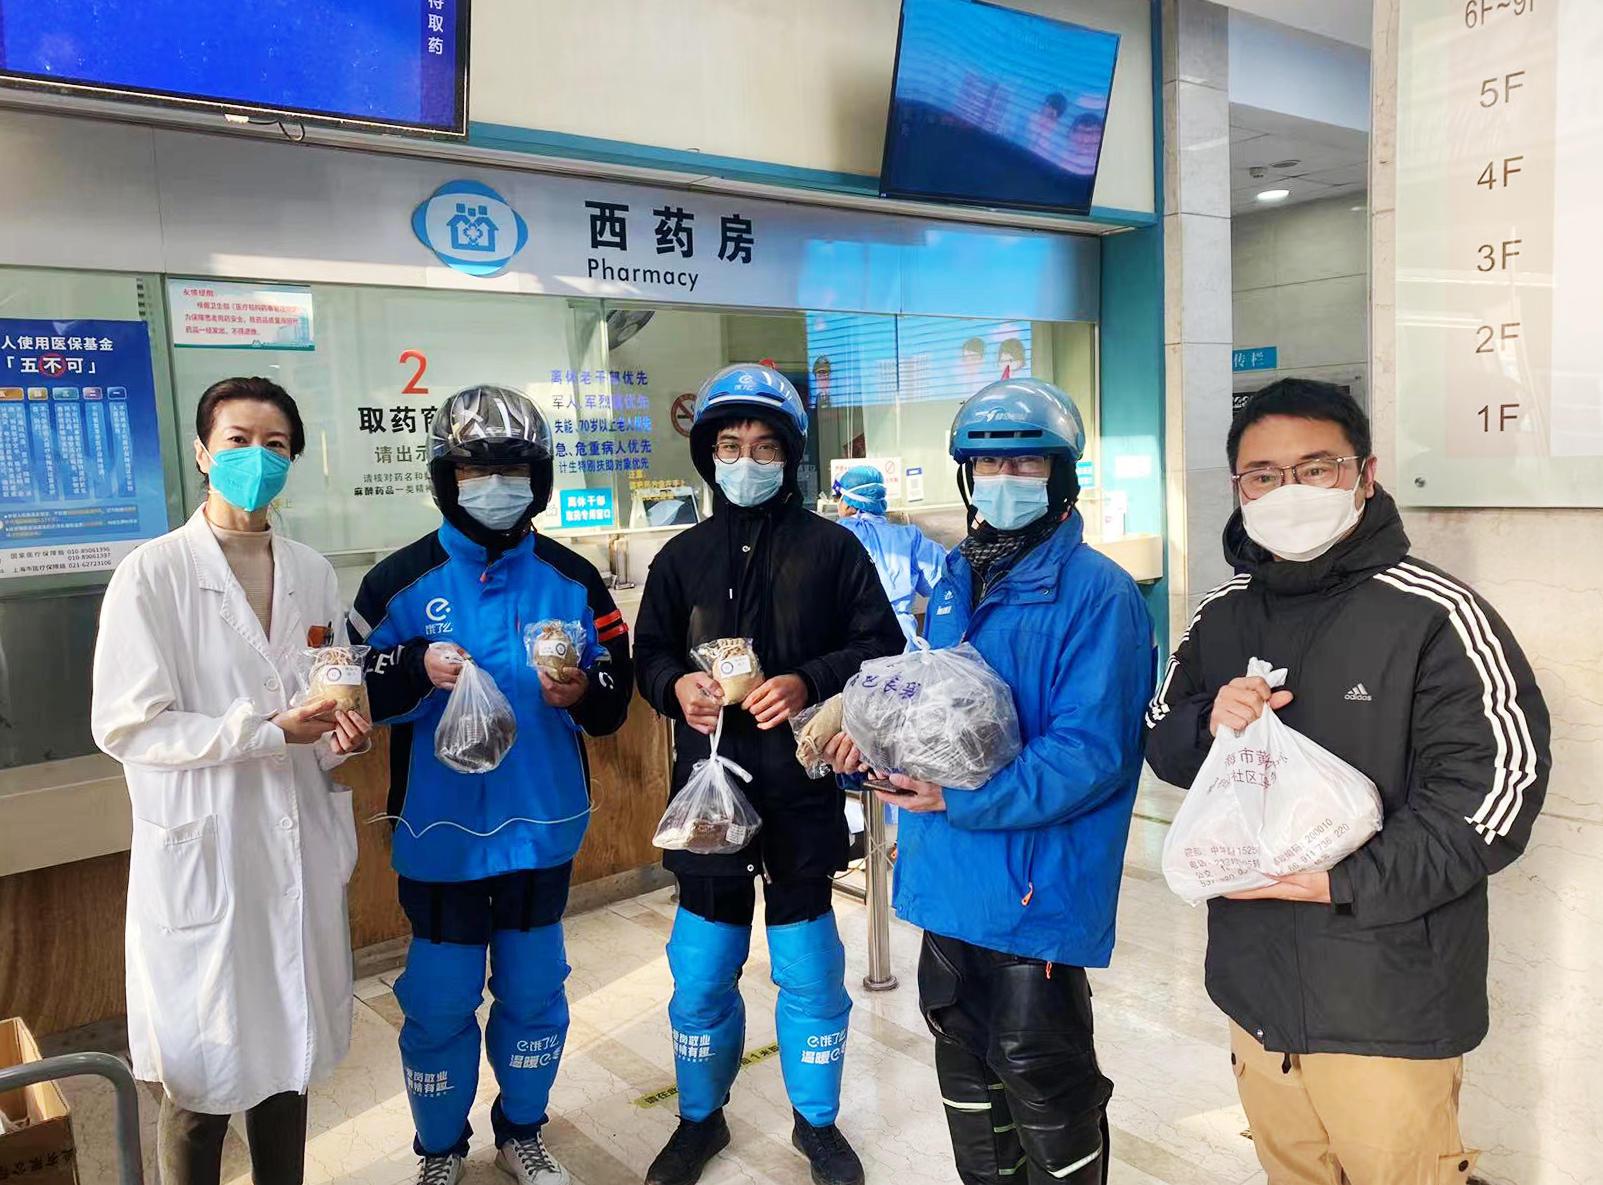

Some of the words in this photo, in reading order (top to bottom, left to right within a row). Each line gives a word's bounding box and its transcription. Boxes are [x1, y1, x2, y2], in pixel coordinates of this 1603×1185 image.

[1480, 71, 1525, 108] 5F
[1477, 156, 1523, 190] 4F
[585, 200, 755, 264] 西药房
[1477, 239, 1522, 271] 3F
[588, 258, 699, 291] Pharmacy
[1, 336, 113, 351] 人使用医保基金
[1476, 322, 1520, 353] 2F
[399, 349, 429, 394] 2
[1478, 404, 1520, 432] 1F
[555, 440, 652, 457] 急、危重病人优先
